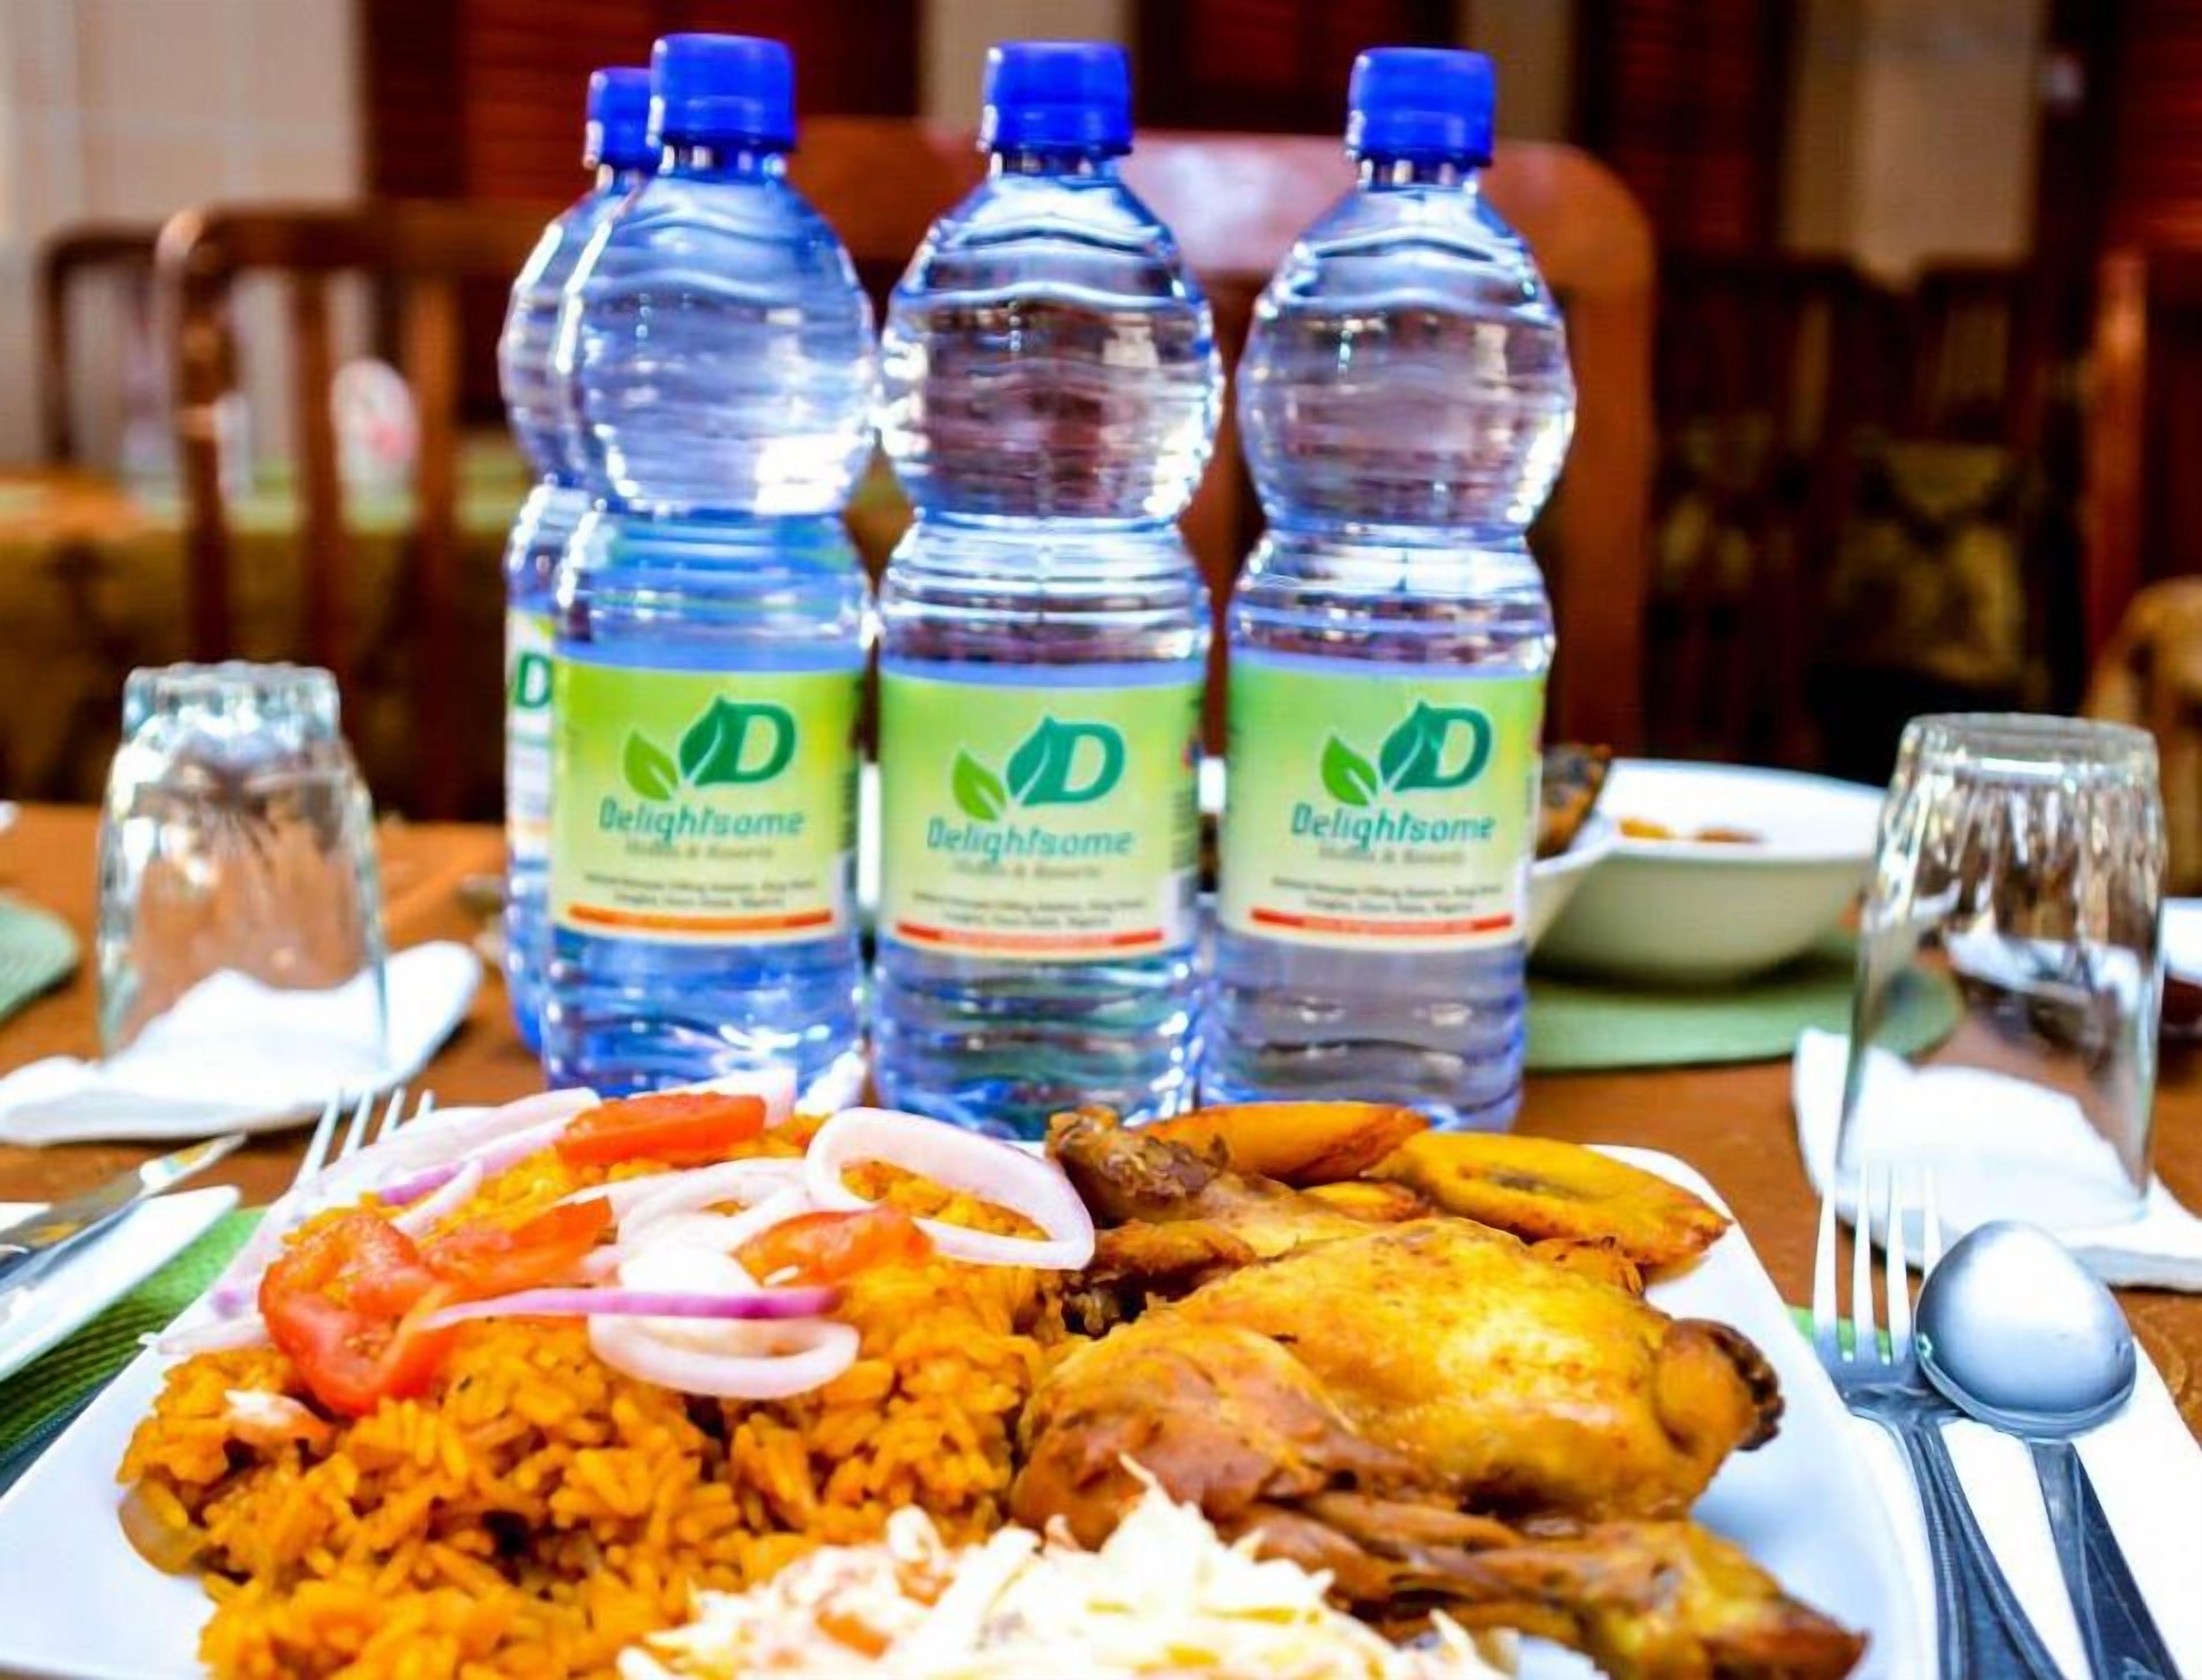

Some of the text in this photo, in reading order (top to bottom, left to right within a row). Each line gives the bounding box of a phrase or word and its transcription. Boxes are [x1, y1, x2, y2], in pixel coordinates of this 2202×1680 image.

[599, 796, 804, 844] Delightsome
[927, 817, 1134, 863] Delightsome
[1290, 802, 1496, 850] Delightsome
